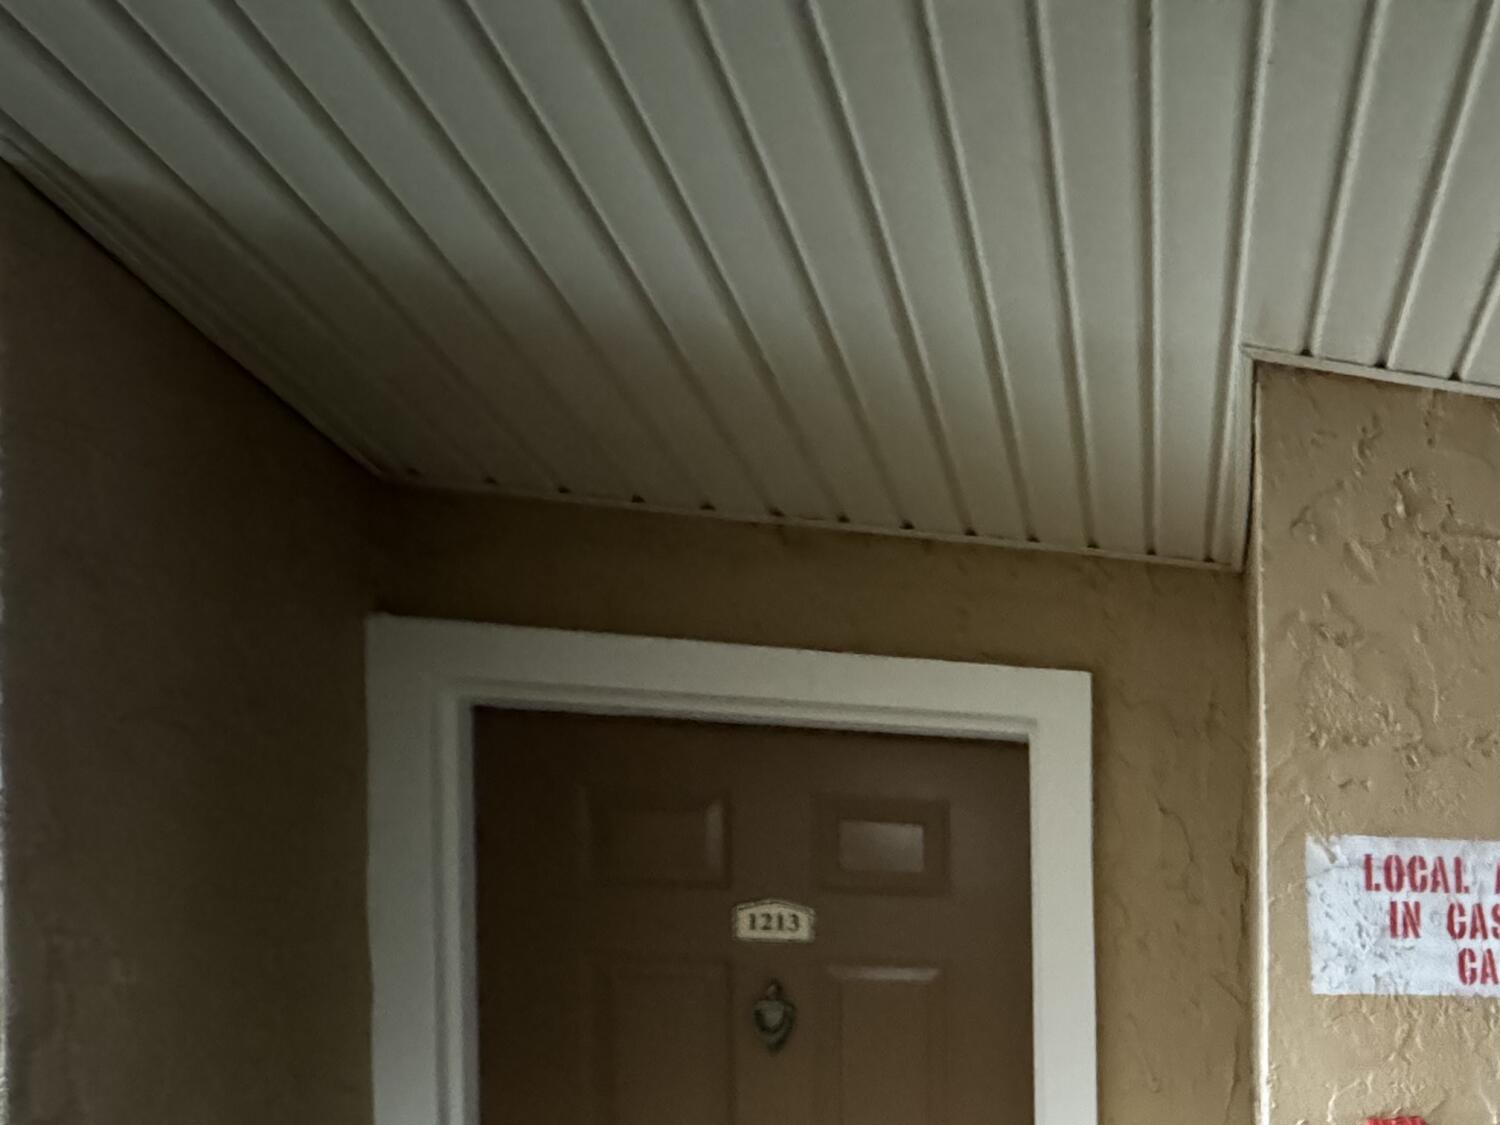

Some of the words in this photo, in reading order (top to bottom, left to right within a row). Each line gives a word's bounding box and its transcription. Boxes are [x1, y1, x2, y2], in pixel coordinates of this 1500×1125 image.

[1363, 853, 1470, 893] LOCAL
[748, 912, 800, 932] 1213
[1388, 901, 1421, 939] IN
